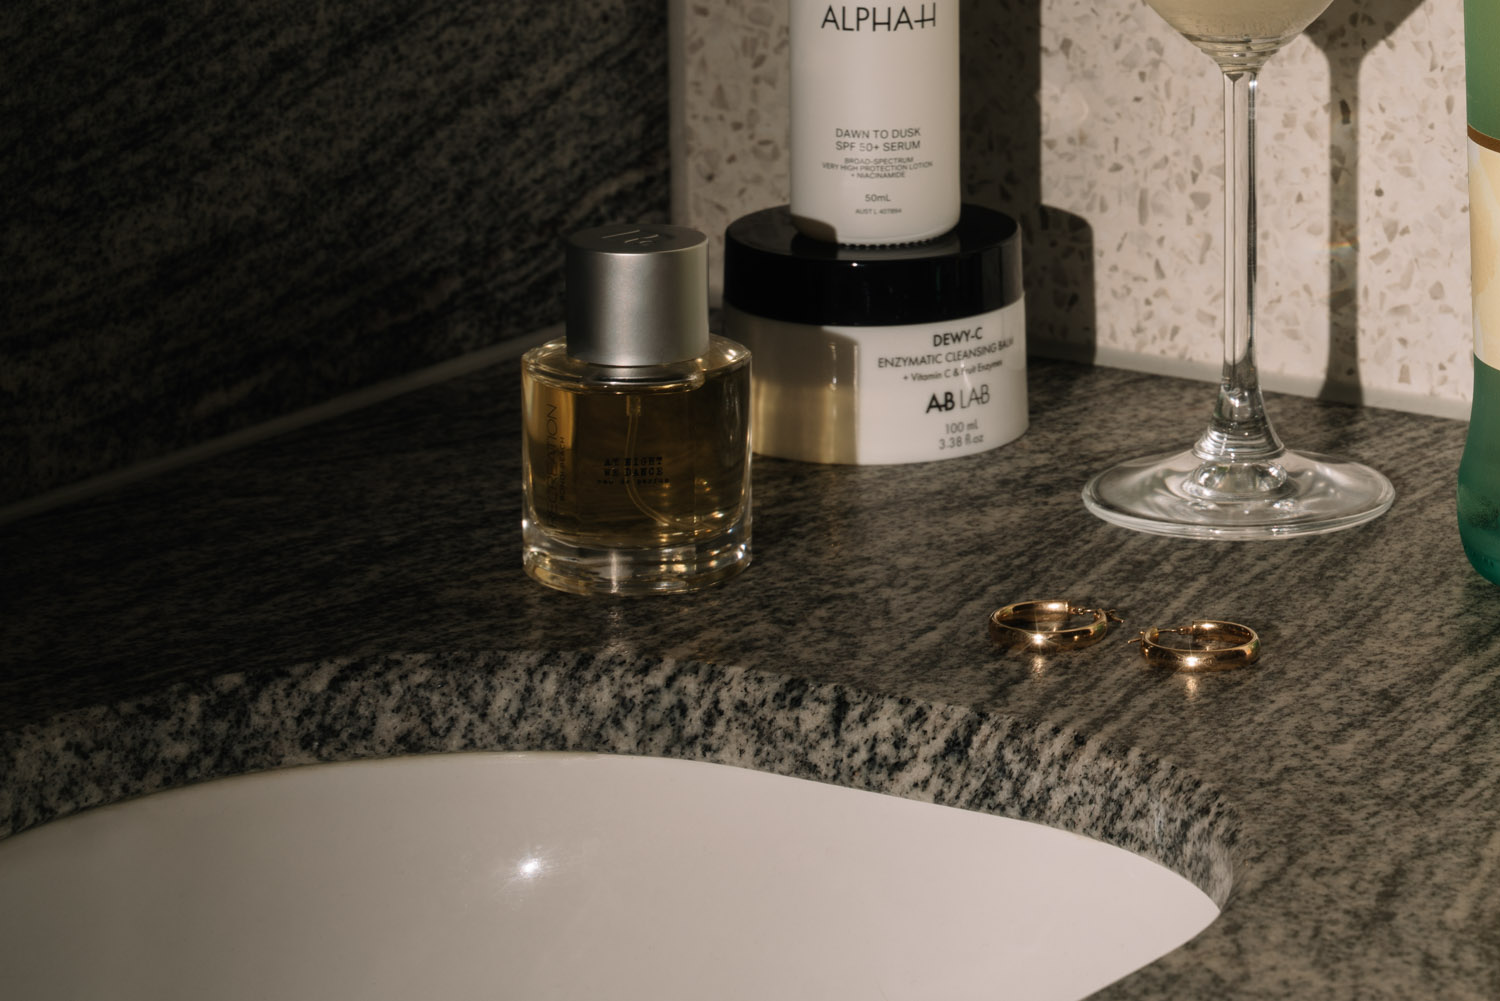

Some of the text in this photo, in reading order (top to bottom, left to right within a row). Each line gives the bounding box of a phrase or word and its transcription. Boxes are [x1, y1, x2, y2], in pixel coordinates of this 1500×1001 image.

[835, 127, 921, 139] DAWN TO DUSK
[835, 140, 921, 152] SPF 50+ SERUM
[822, 162, 839, 170] VERY
[860, 164, 909, 172] PROTECTION
[909, 161, 934, 170] LOTION
[844, 157, 914, 165] BROAD-SPECTRUM
[864, 194, 891, 202] 50mL
[933, 327, 983, 347] DEWY-C
[878, 354, 942, 368] ENZYMATIC
[945, 342, 997, 363] CLEANSING
[911, 371, 942, 381] Vitamin
[944, 369, 951, 378] C
[952, 368, 960, 377] &
[945, 422, 965, 434] 100
[938, 437, 963, 450] 3.38
